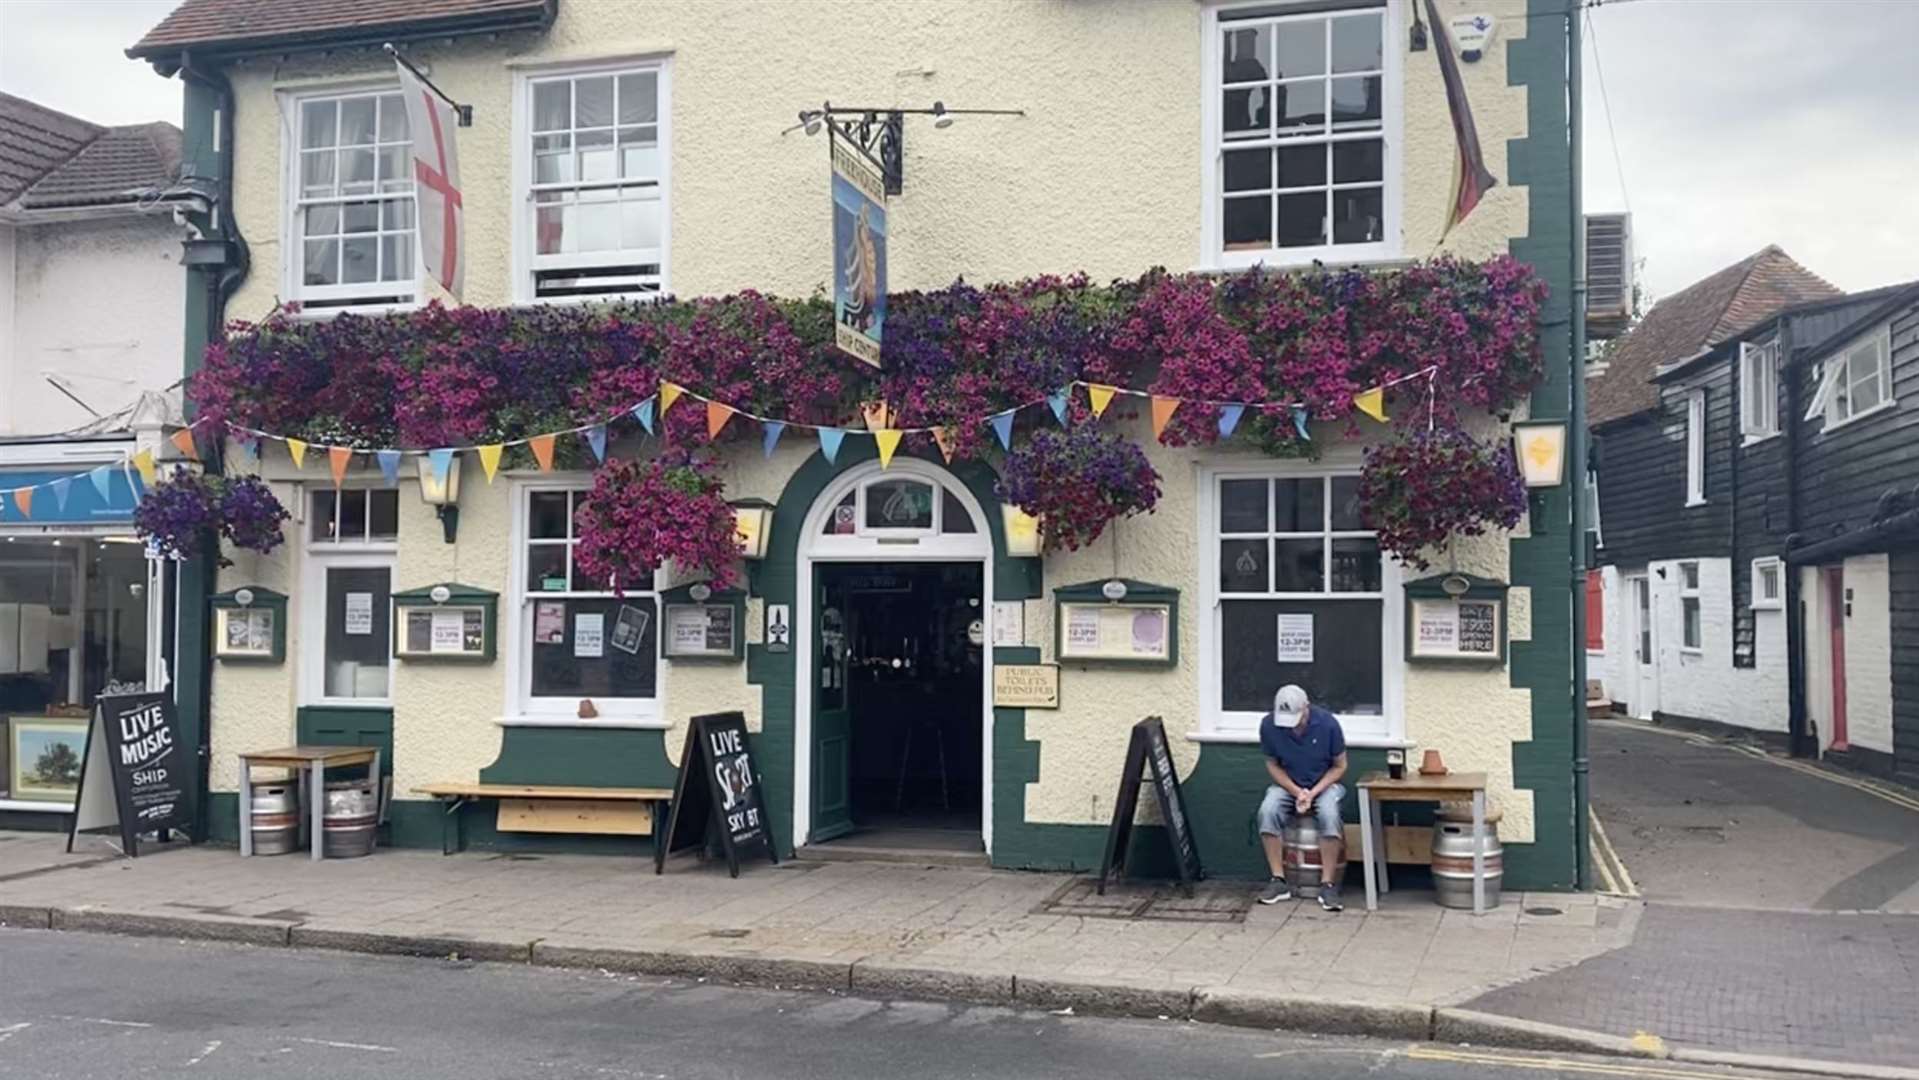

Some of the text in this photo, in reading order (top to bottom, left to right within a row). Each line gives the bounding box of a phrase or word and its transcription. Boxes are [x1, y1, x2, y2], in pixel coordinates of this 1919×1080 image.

[1280, 638, 1311, 646] 12-3PM
[1005, 676, 1047, 685] TOILETS
[120, 706, 163, 740] LIVE
[120, 727, 172, 764] MUSIC
[710, 729, 742, 756] LIVE
[132, 769, 167, 785] SHIP
[715, 753, 752, 811] SPRT
[728, 808, 759, 832] SKY BT
